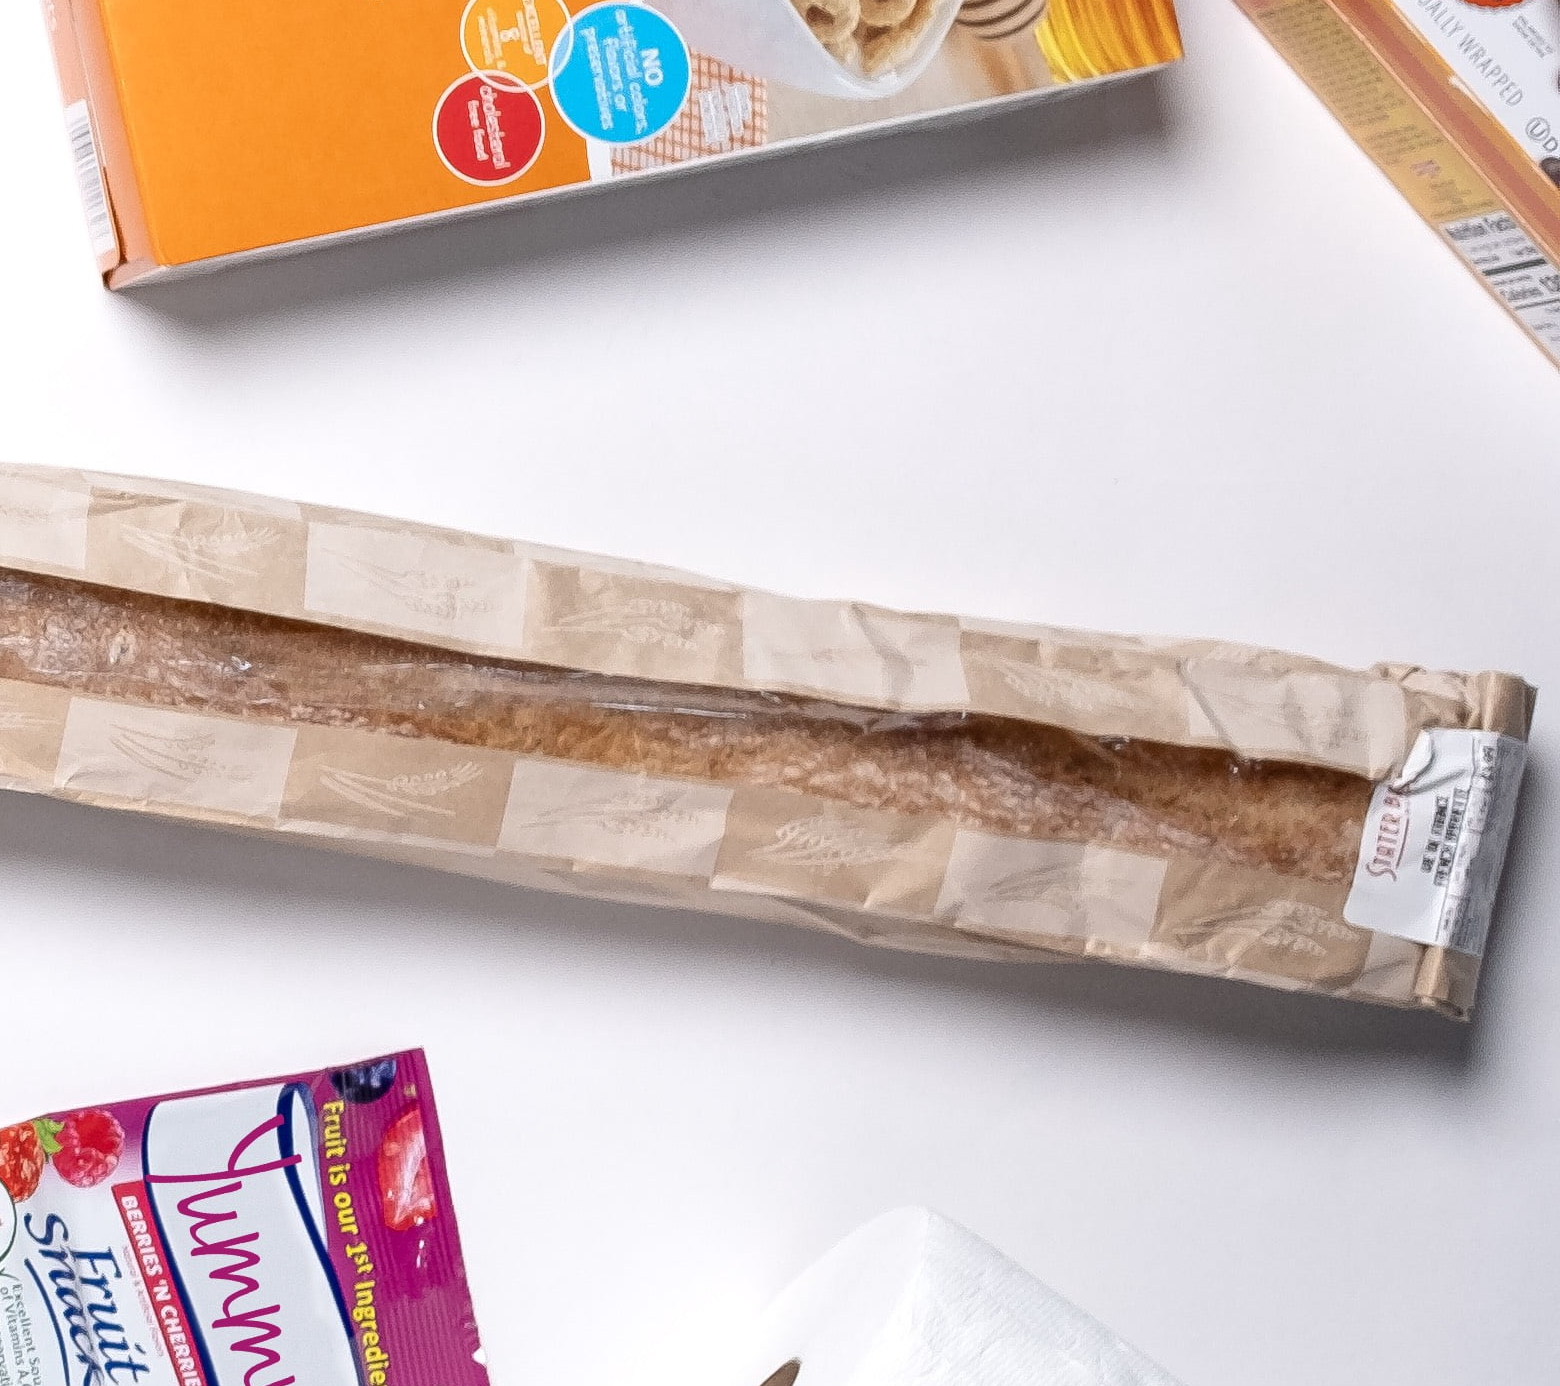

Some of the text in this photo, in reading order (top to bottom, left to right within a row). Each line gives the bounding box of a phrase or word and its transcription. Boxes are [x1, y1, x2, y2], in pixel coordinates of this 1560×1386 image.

[641, 46, 664, 87] NO
[1458, 28, 1524, 107] WRAPPED
[323, 1100, 350, 1160] Fruit
[328, 1162, 350, 1187] is
[120, 1194, 163, 1277] BERRIES
[333, 1193, 359, 1236] our
[345, 1241, 375, 1275] 1st
[71, 1246, 150, 1385] Fruit
